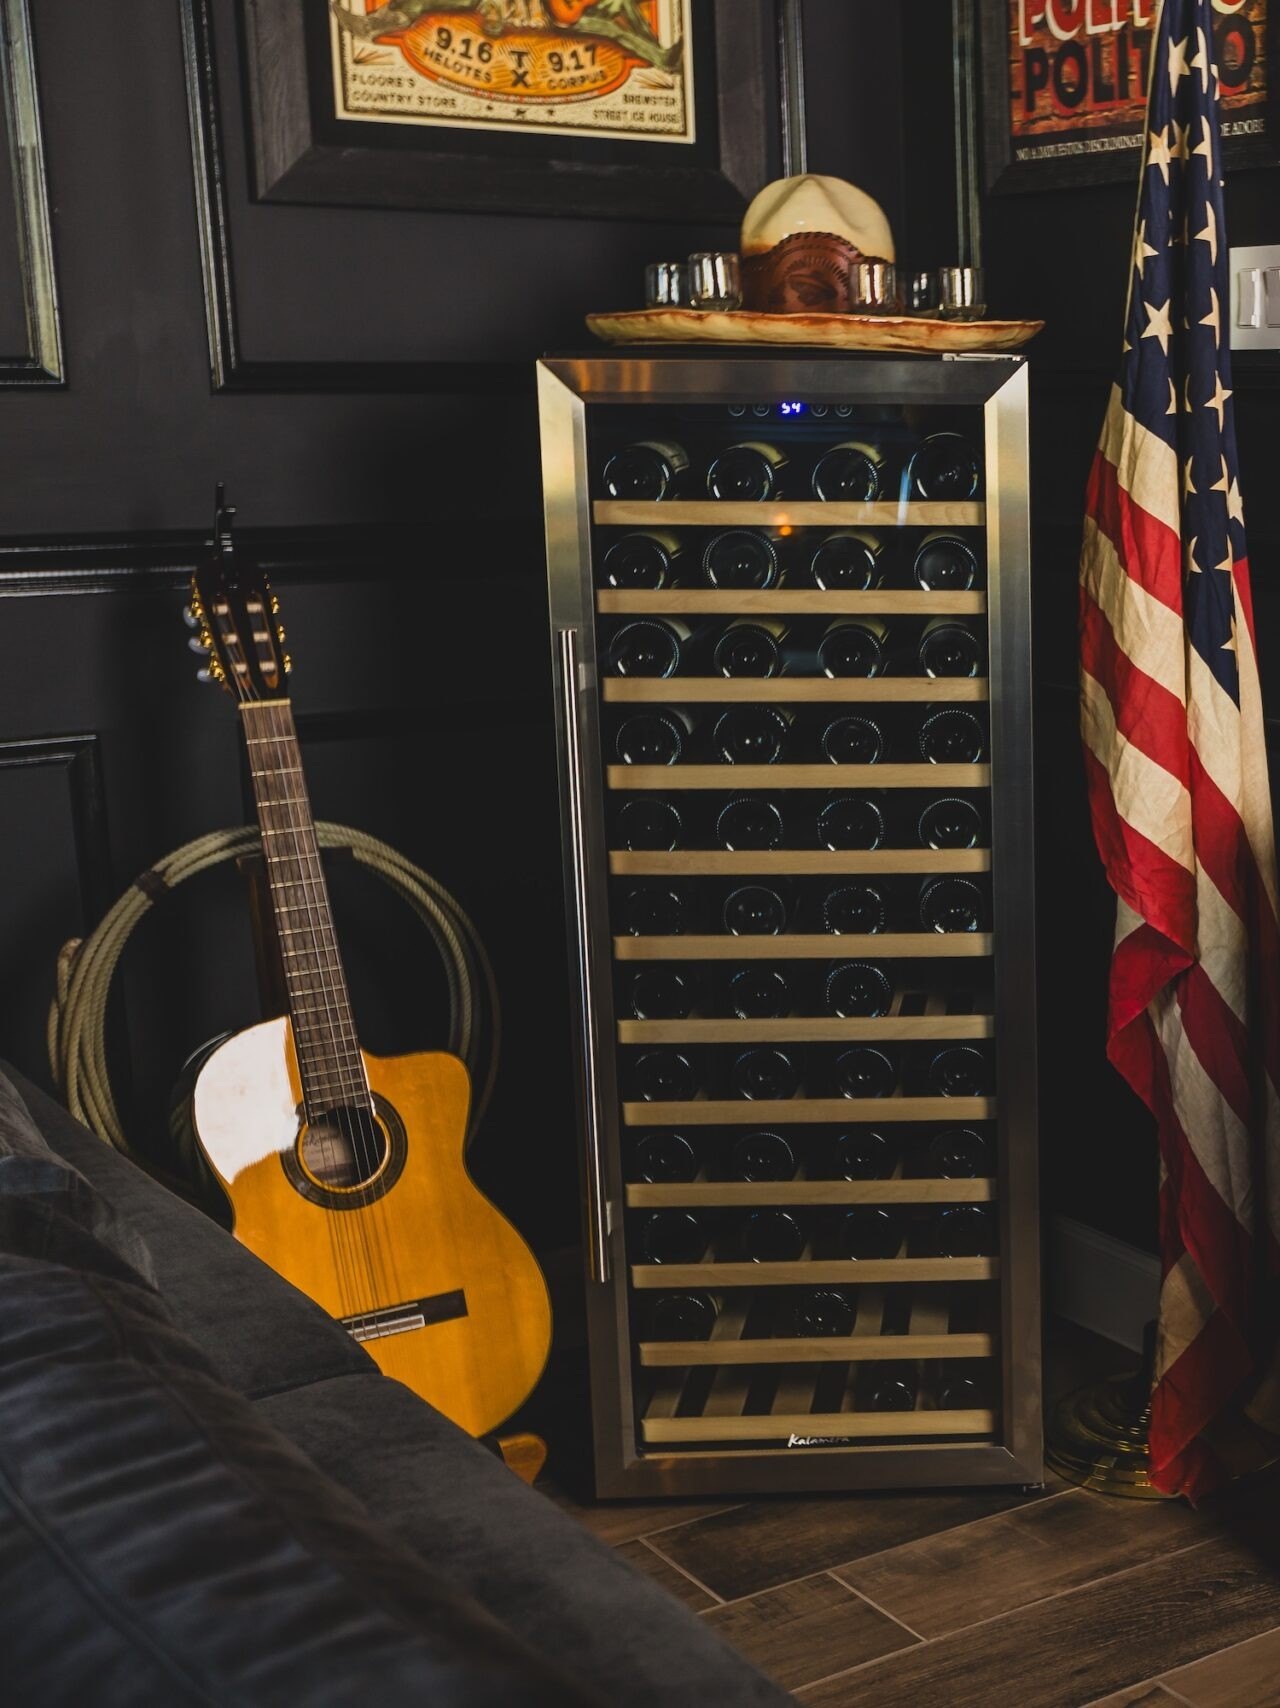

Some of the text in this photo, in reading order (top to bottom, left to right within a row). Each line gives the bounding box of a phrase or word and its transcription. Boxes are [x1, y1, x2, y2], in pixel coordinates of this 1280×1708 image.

[437, 28, 493, 64] 9.16
[423, 47, 493, 83] HELOTES
[547, 43, 598, 73] 9.17
[547, 70, 606, 90] CORPUS
[352, 91, 457, 108] COUNTRY STORE
[623, 93, 676, 107] BREWSTER
[592, 109, 629, 122] STREET
